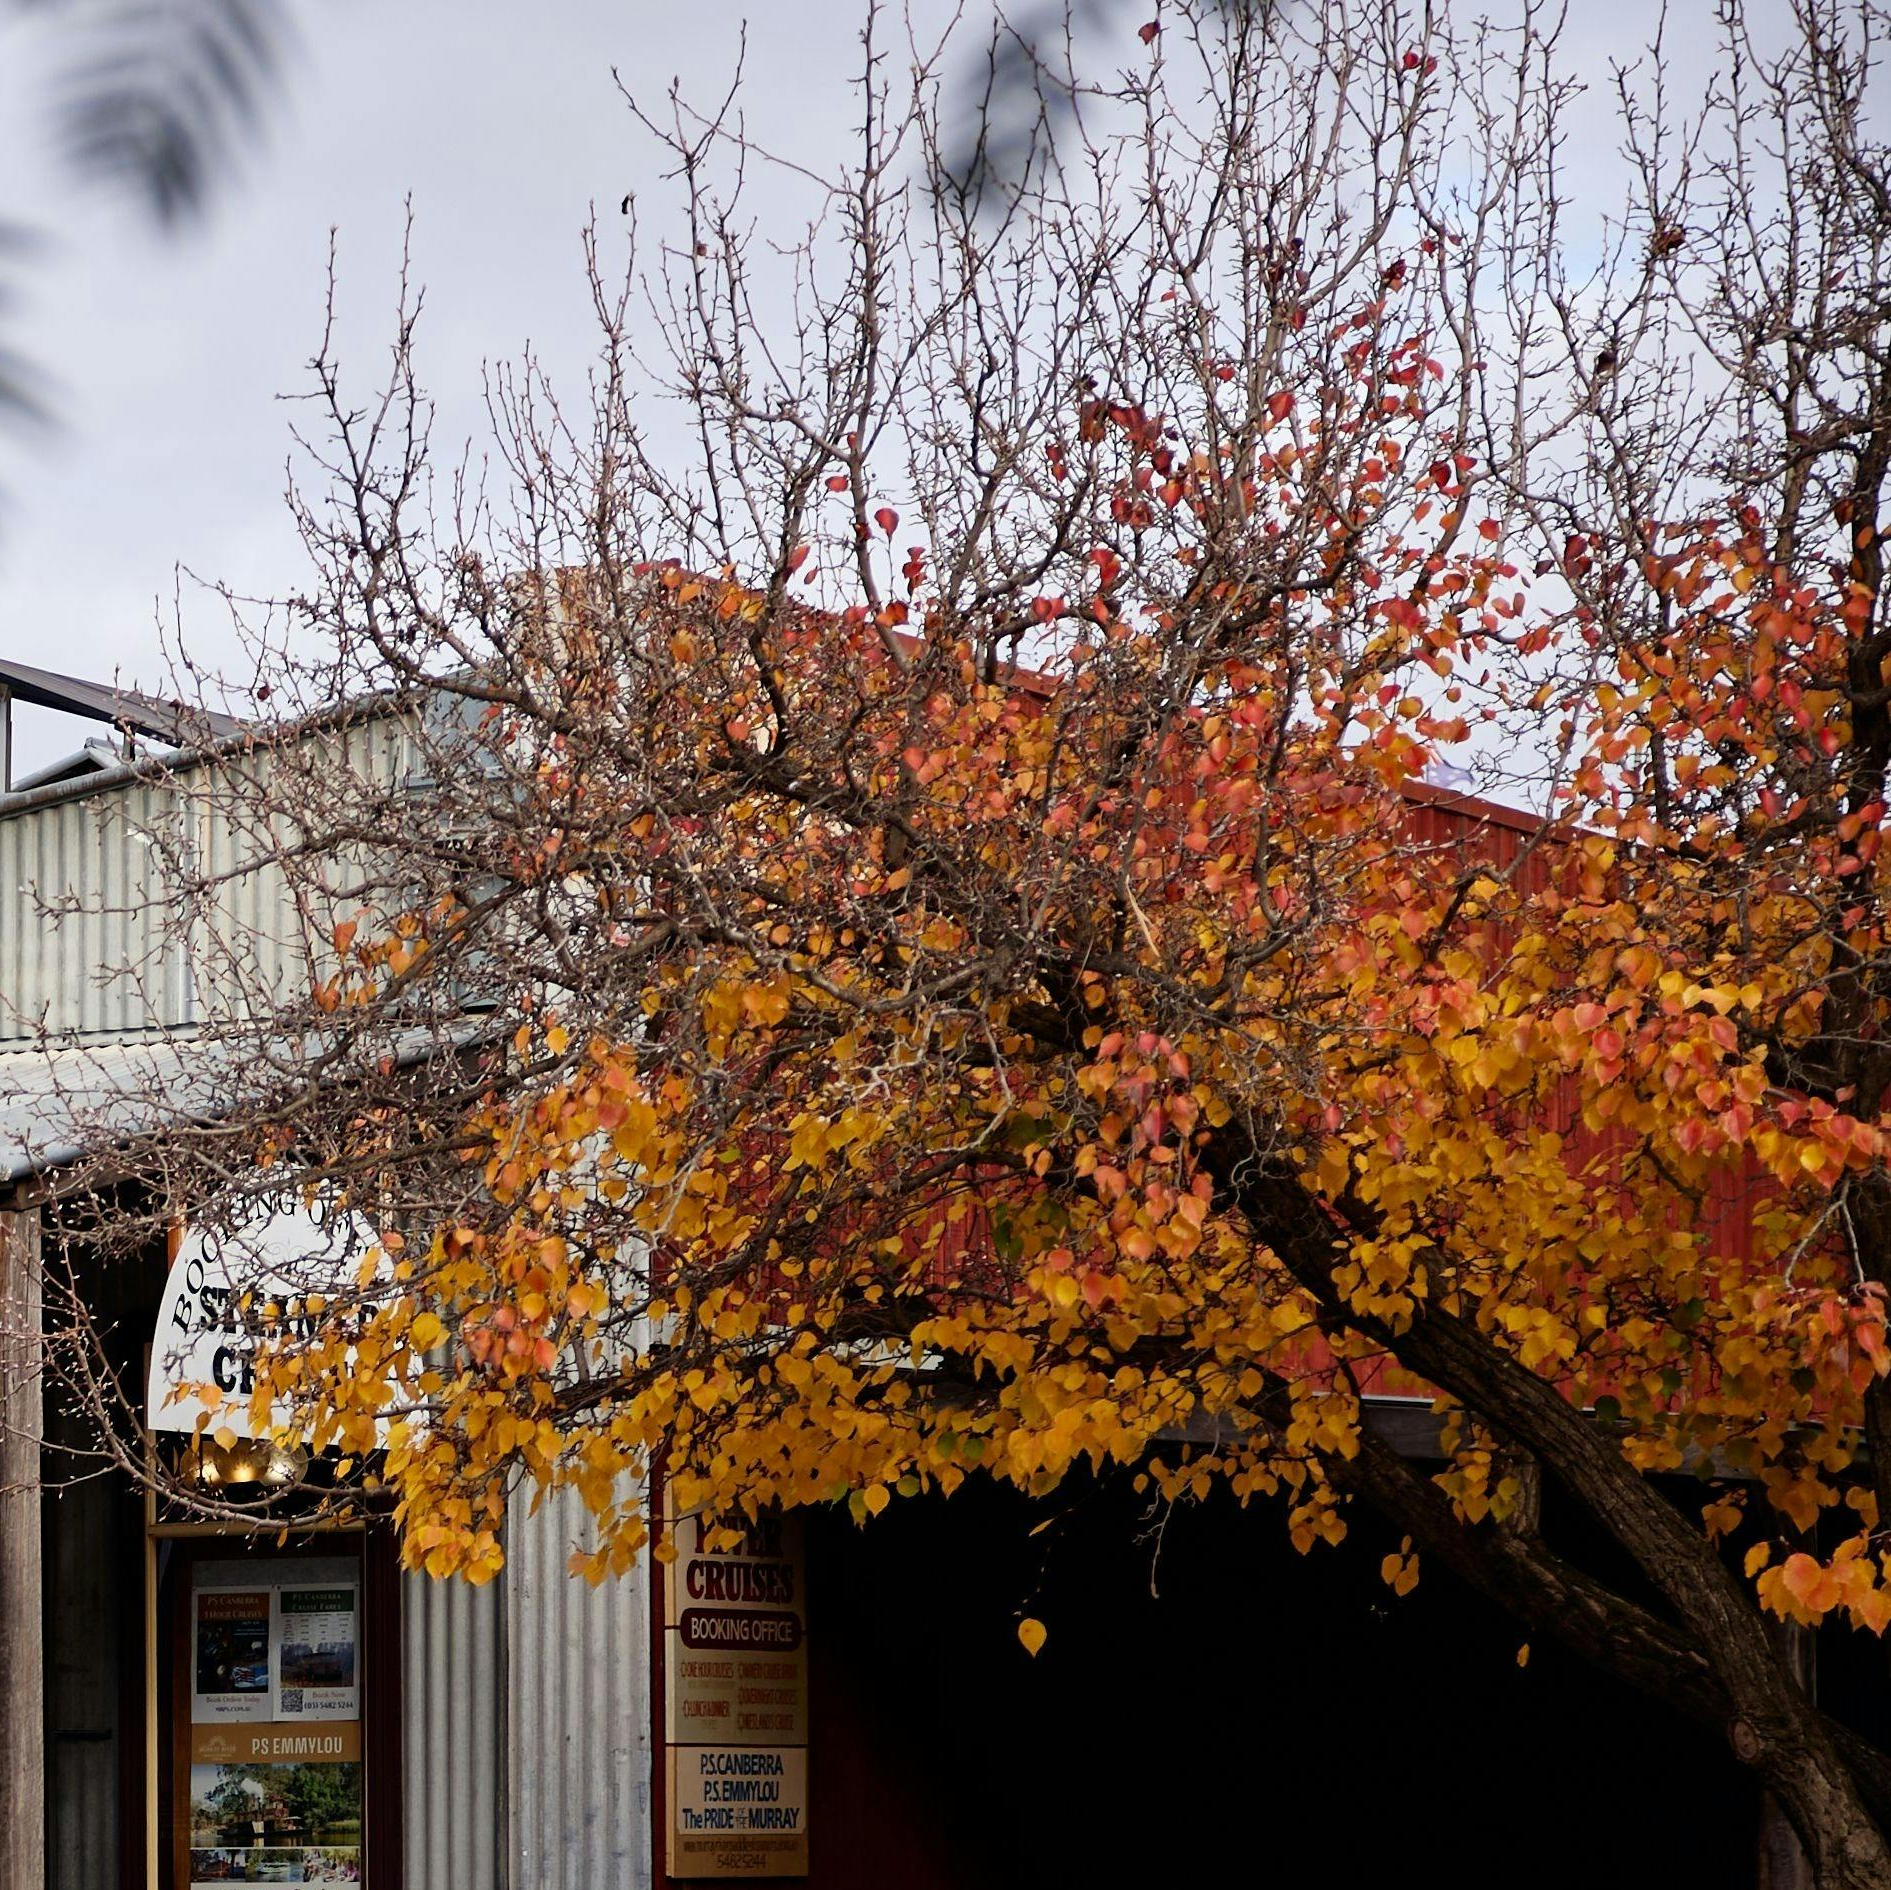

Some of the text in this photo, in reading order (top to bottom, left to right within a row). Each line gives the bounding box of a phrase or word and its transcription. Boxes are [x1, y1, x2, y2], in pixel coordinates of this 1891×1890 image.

[686, 1559, 794, 1604] CRUISES
[691, 1617, 793, 1642] BOOKING OFFICE
[252, 1736, 343, 1755] PS EMMYLOU
[683, 1807, 800, 1829] The PRIDE MURRAY
